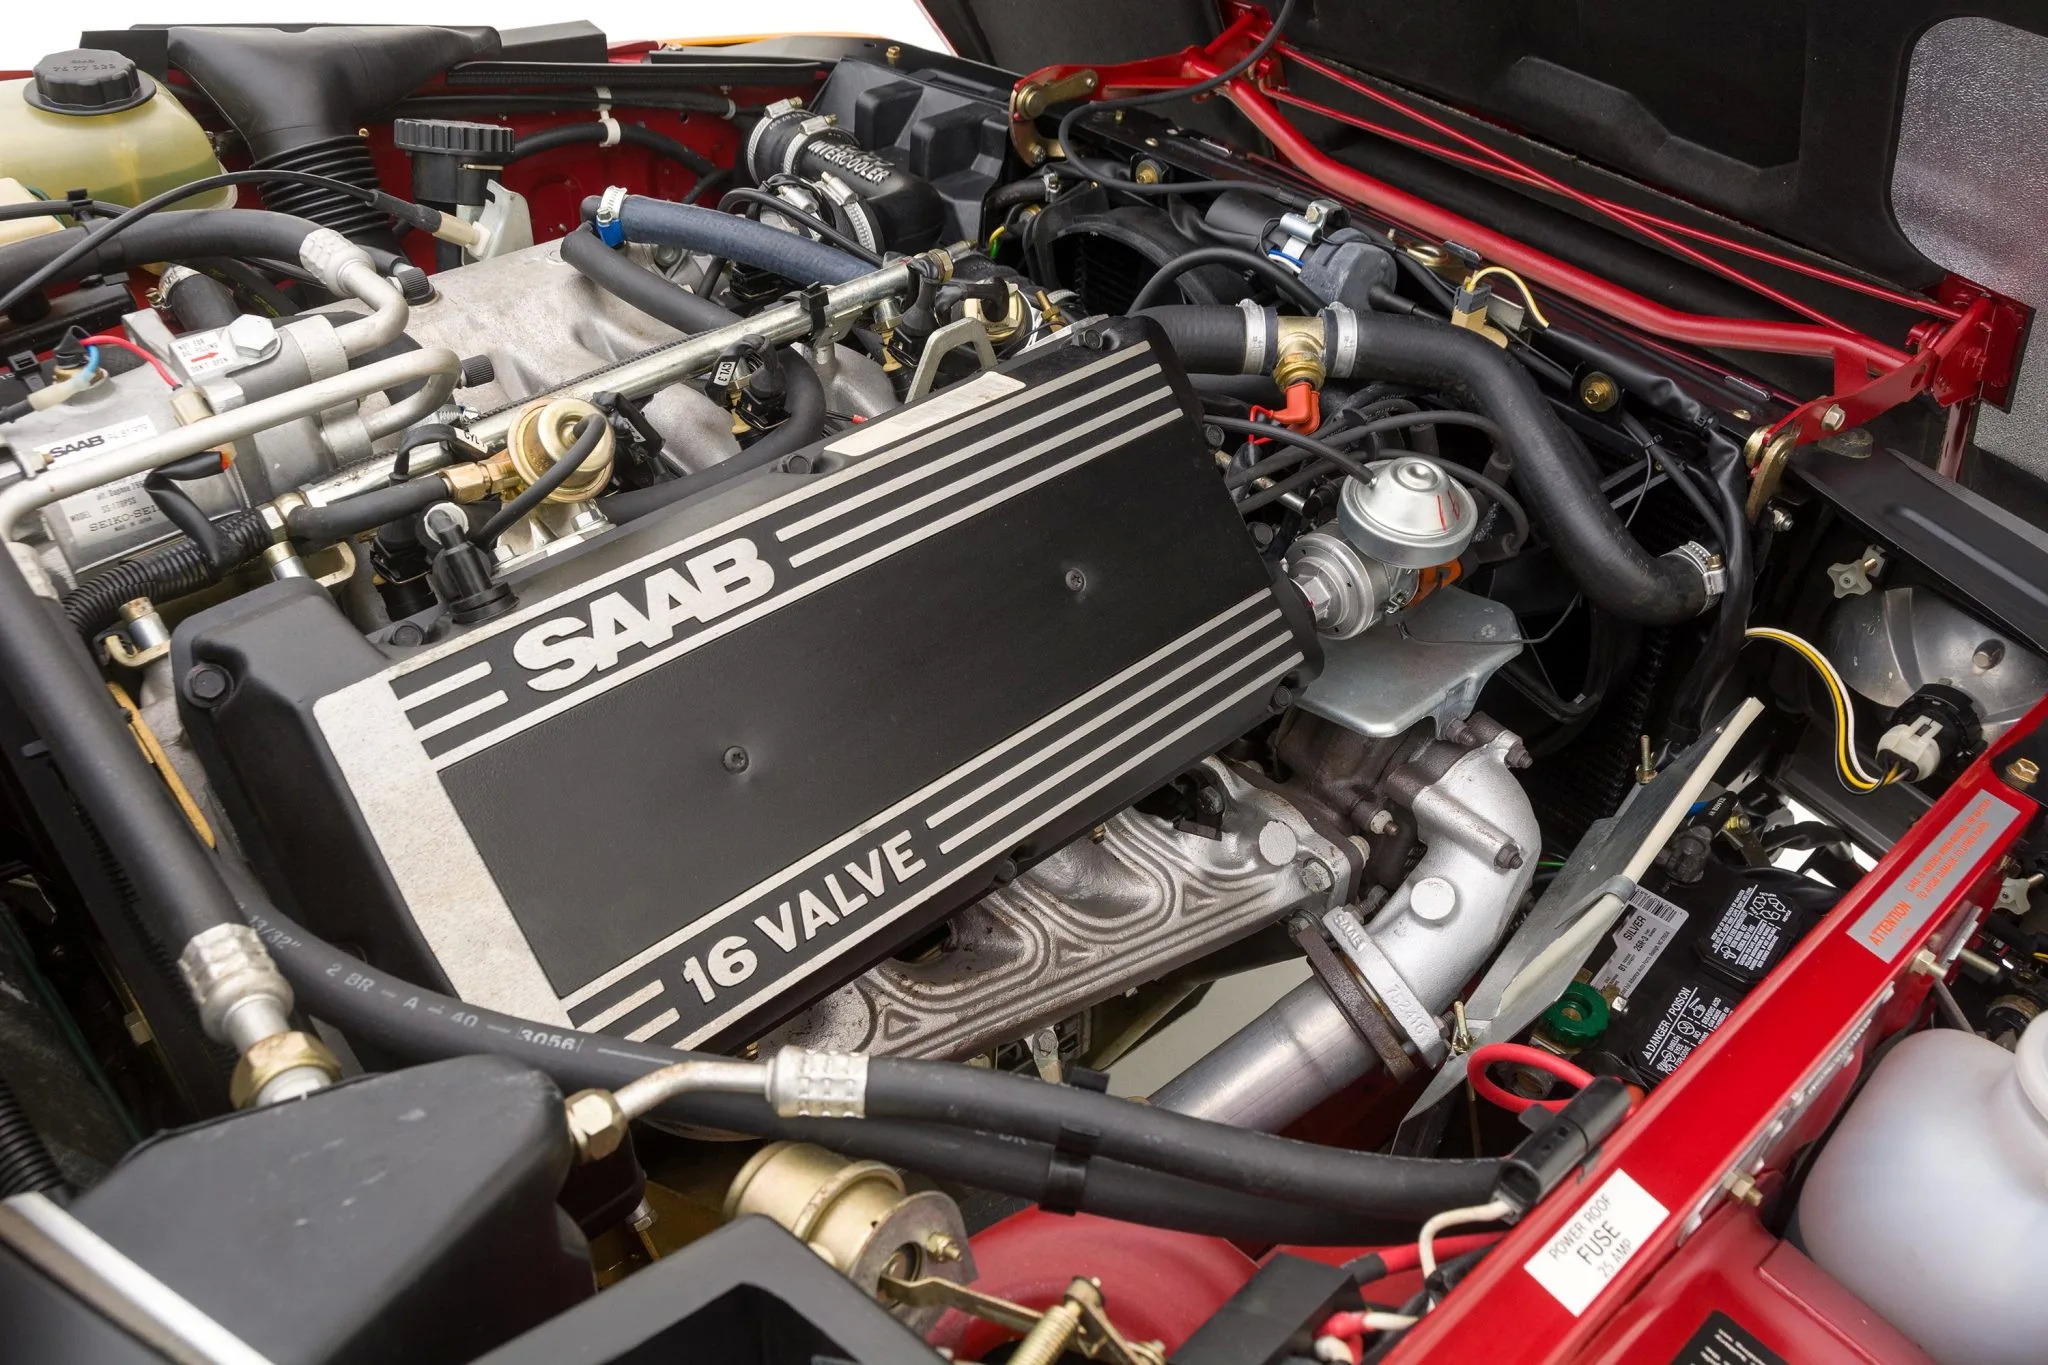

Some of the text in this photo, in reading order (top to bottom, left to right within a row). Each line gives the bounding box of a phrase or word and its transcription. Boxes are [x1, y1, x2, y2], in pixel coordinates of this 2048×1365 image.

[807, 140, 891, 186] INTERCOOLER
[720, 362, 732, 376] CYL
[49, 435, 105, 459] SAAB
[513, 536, 776, 691] SAAB
[683, 830, 927, 1003] 16 VALVE
[1622, 914, 1646, 941] SILVER
[1868, 900, 1912, 946] ATTENTION
[325, 963, 342, 977] 2
[344, 972, 375, 993] BR
[403, 996, 420, 1010] A
[450, 1011, 479, 1028] 40
[1645, 1018, 1671, 1052] DANGER
[1668, 986, 1691, 1016] POISON
[1692, 1030, 1701, 1039] NO
[1548, 1193, 1611, 1260] POWER ROOF
[1577, 1220, 1621, 1265] FUSE
[1597, 1238, 1631, 1278] 25 AMP
